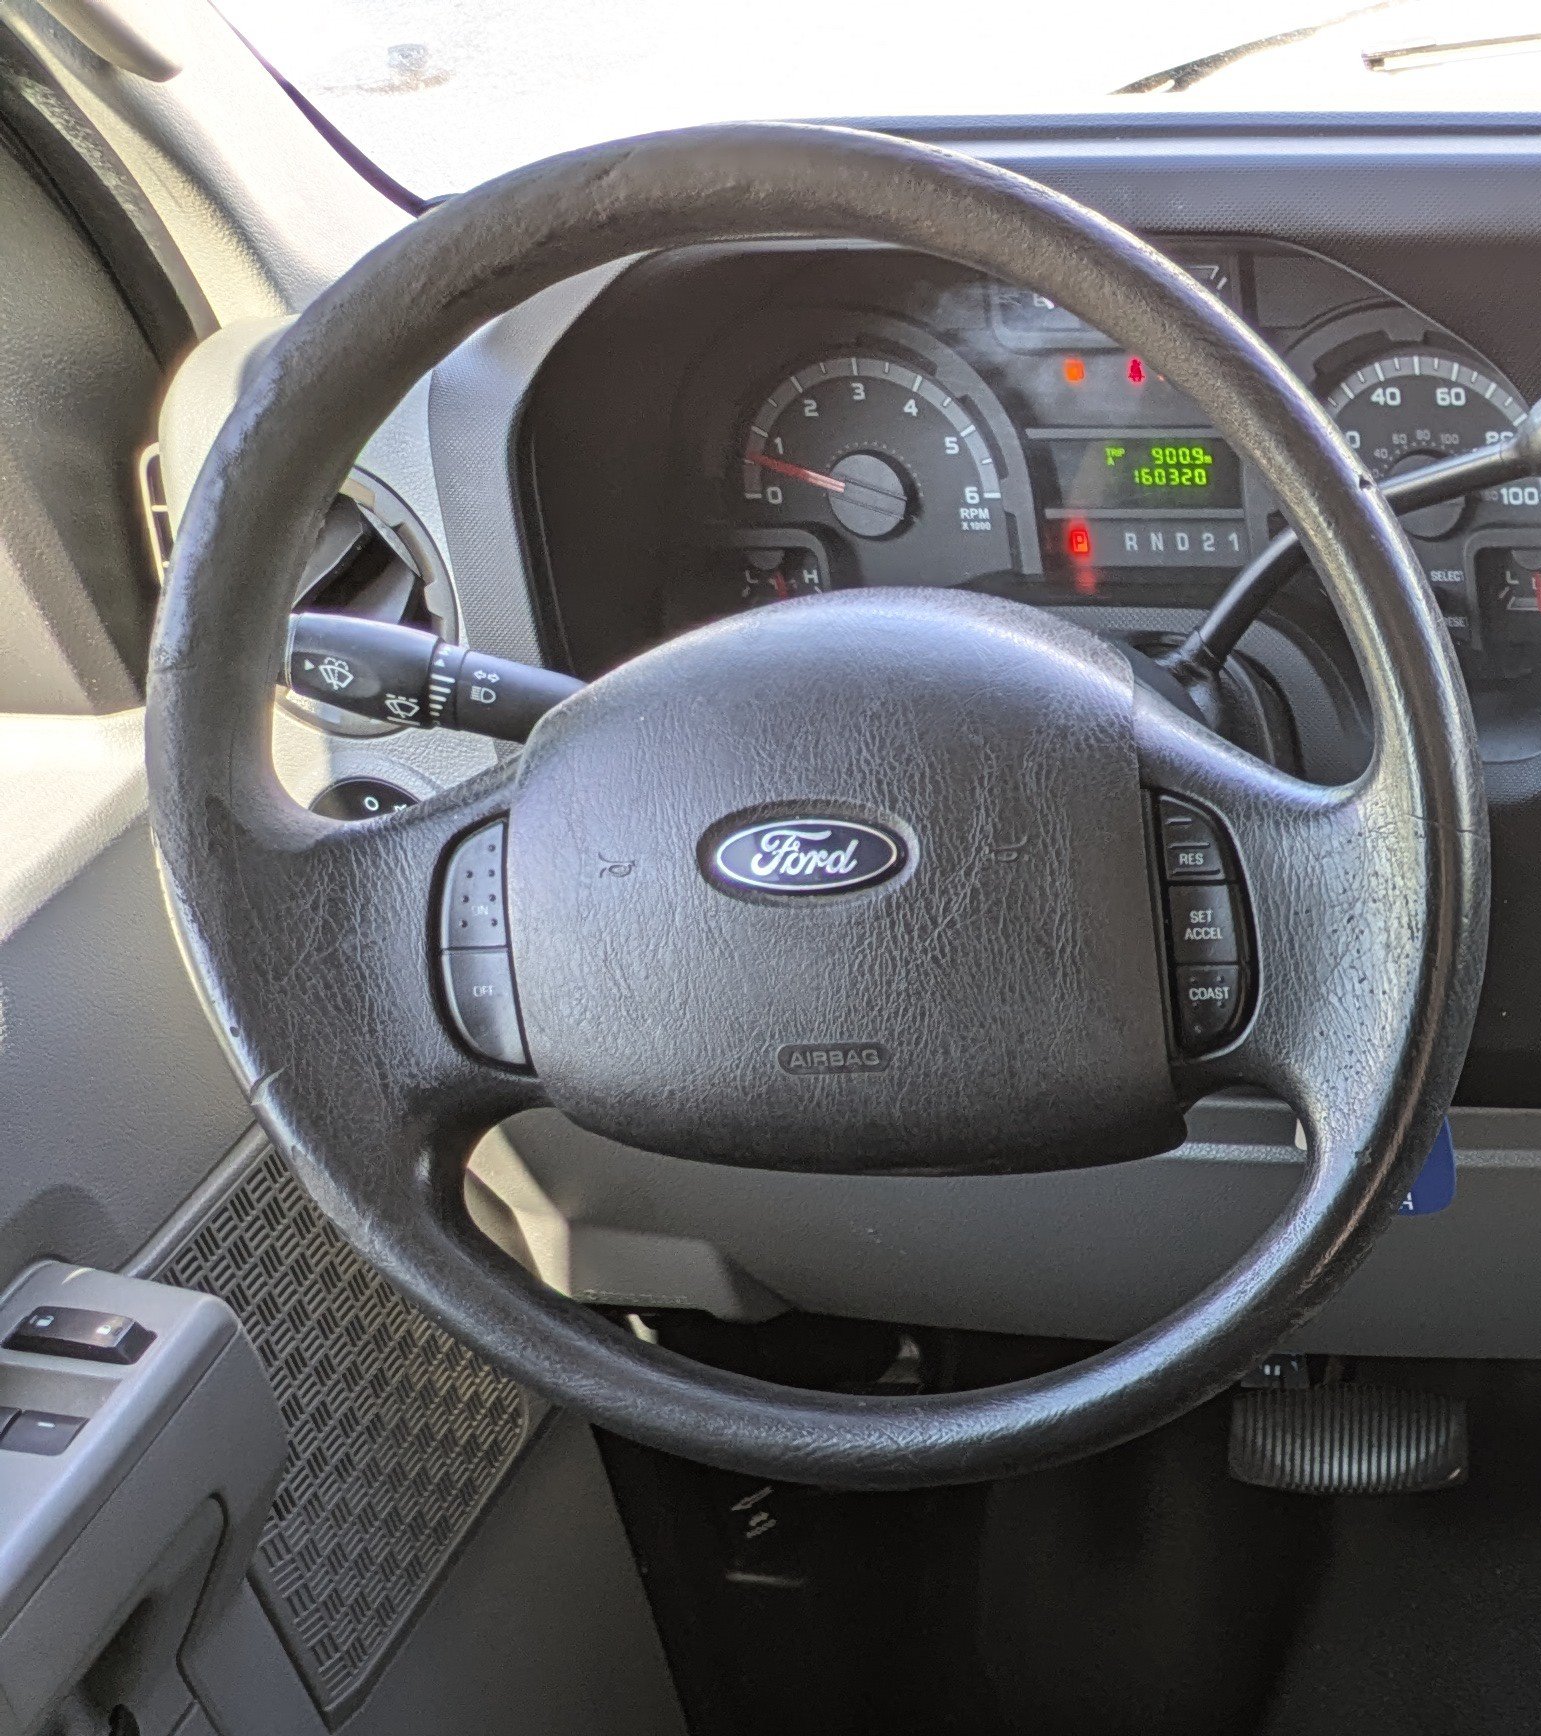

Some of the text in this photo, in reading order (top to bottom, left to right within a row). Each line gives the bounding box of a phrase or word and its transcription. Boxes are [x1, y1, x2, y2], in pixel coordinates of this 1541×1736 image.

[851, 382, 866, 400] 3
[1370, 387, 1401, 406] 40
[1436, 387, 1466, 406] 60
[804, 400, 819, 417] 2
[903, 400, 918, 417] 4
[774, 437, 784, 455] 1
[944, 437, 960, 455] 5
[1133, 468, 1207, 486] 160320
[766, 486, 782, 505] 0
[965, 486, 980, 504] 6
[1500, 487, 1539, 506] 100
[960, 508, 990, 520] RPM
[961, 521, 970, 531] X
[1124, 532, 1139, 552] R
[1151, 532, 1164, 552] N
[1176, 532, 1190, 552] D
[1202, 532, 1216, 552] 2
[1228, 532, 1240, 552] 1
[803, 569, 819, 584] H
[751, 829, 860, 876] Ford
[1179, 852, 1205, 866] RES
[1189, 910, 1214, 924] SET
[1184, 926, 1224, 940] ACCEL
[1188, 985, 1230, 1000] COAST
[789, 1048, 881, 1069] AIRBAG
